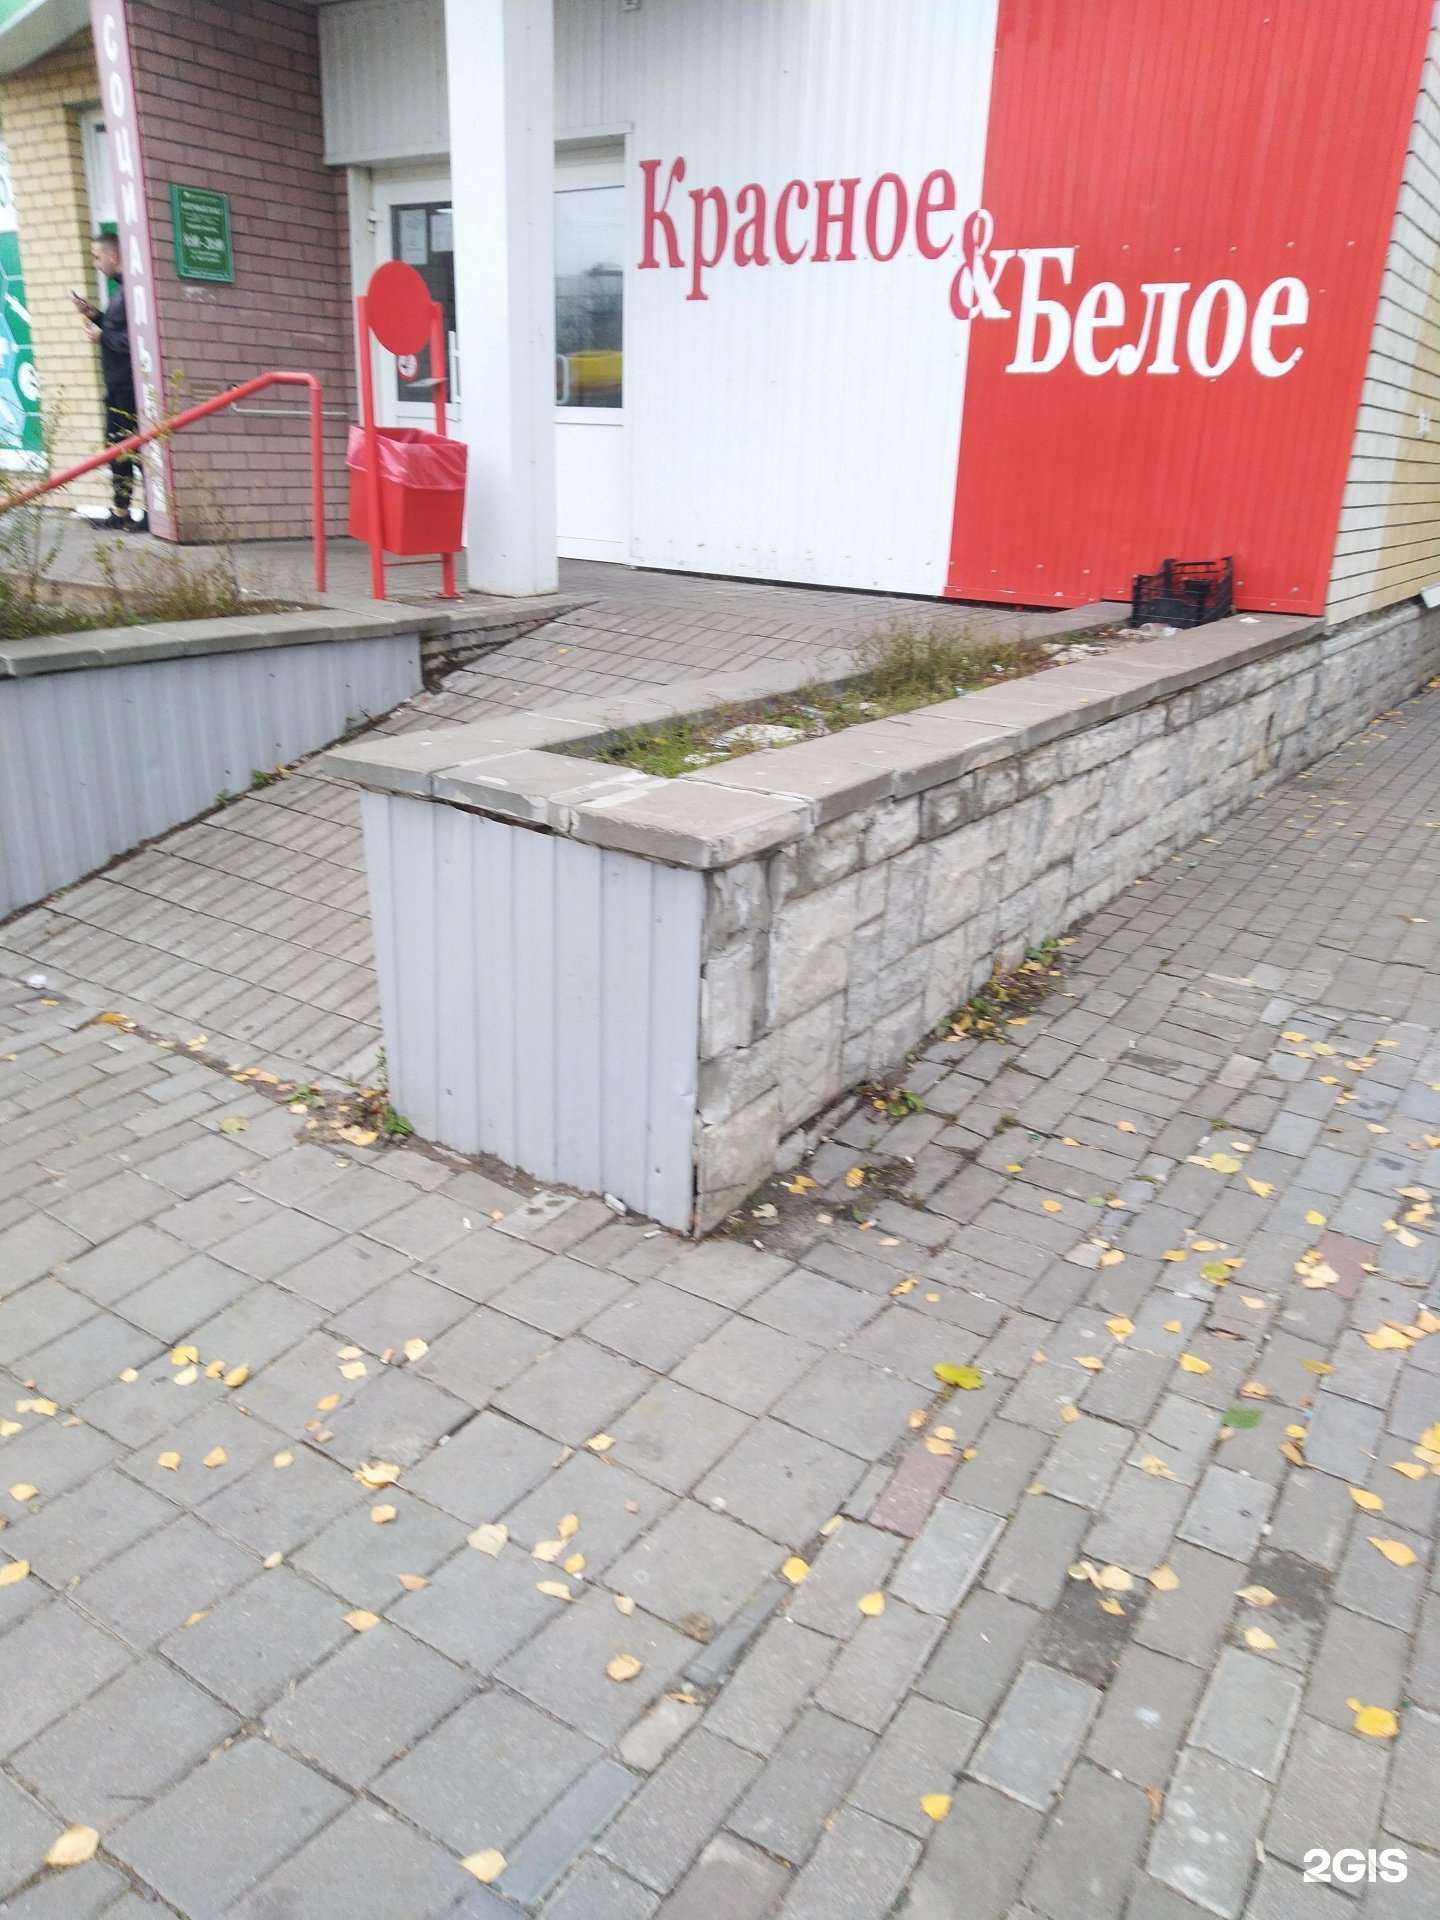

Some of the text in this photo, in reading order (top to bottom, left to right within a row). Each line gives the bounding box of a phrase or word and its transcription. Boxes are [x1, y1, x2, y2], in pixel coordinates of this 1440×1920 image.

[638, 156, 1310, 378] Красное & Белое
